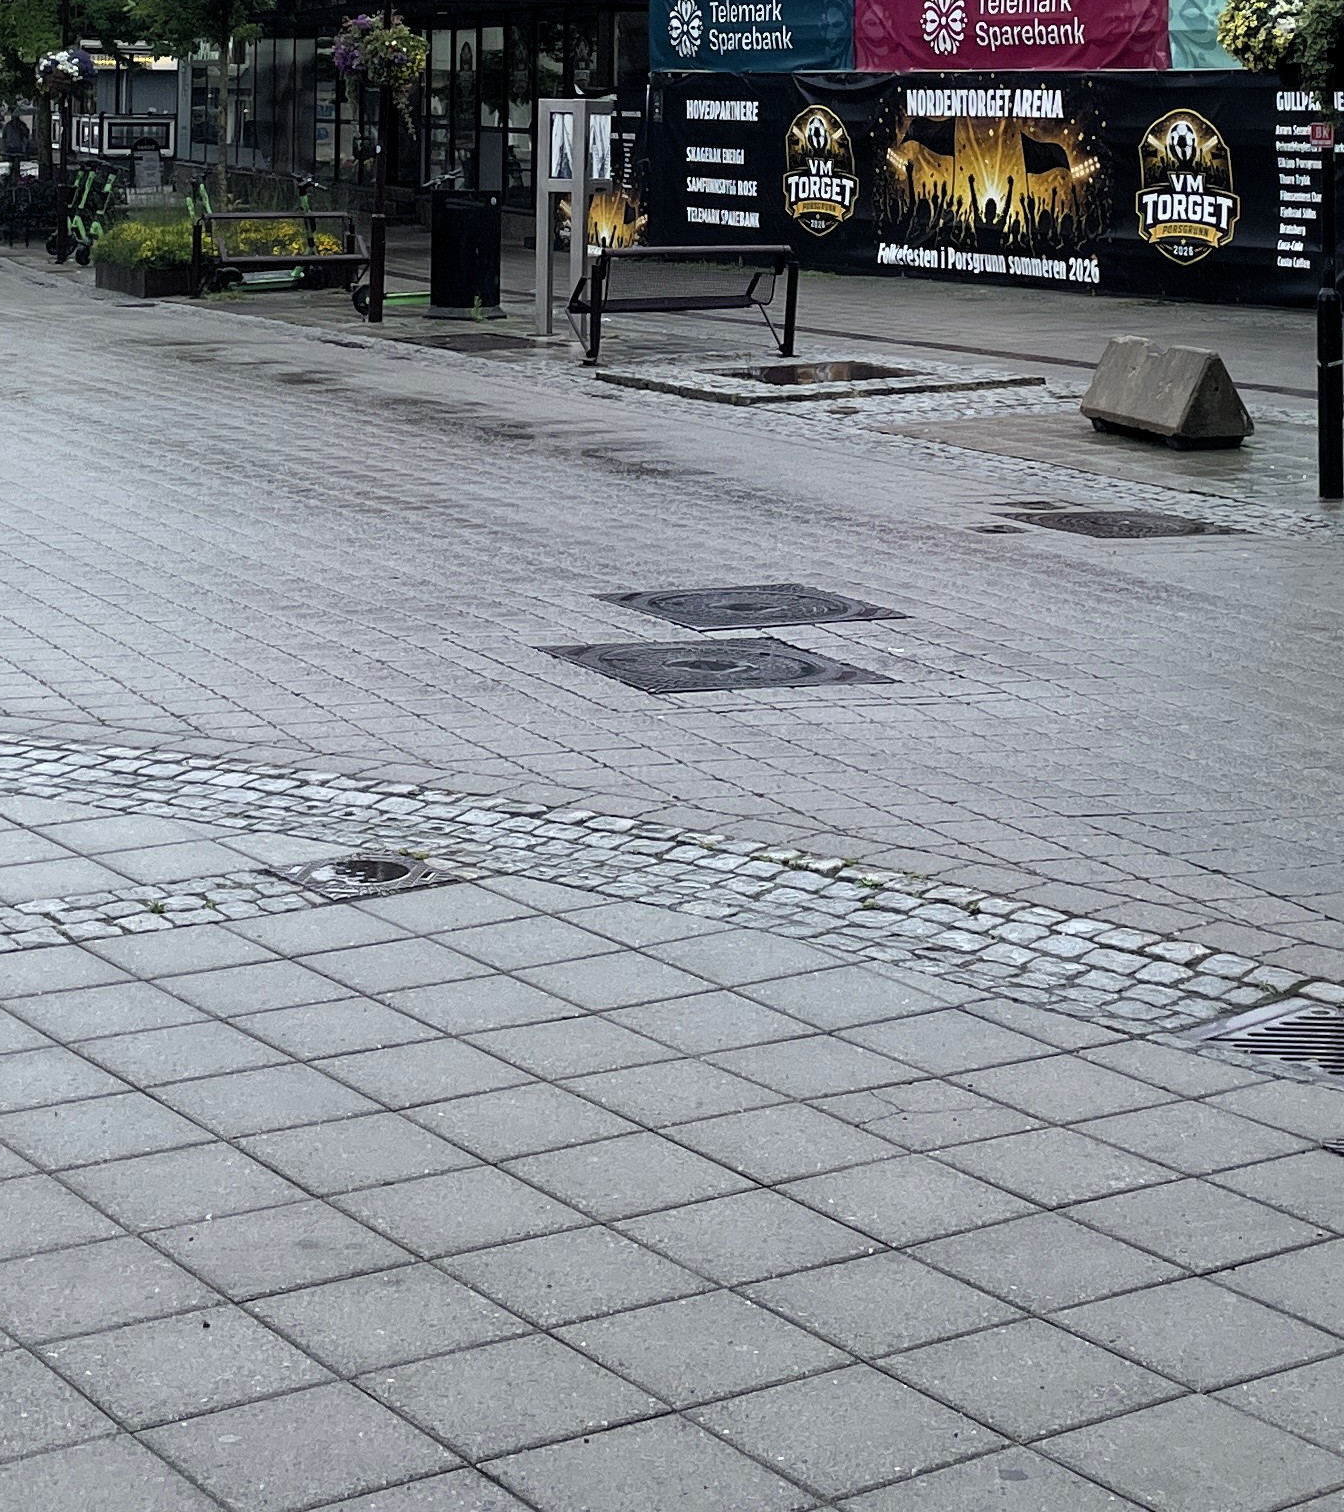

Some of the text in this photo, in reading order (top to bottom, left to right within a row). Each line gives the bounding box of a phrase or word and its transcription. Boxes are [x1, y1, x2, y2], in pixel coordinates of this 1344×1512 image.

[708, 27, 793, 52] Sparebank
[975, 19, 1086, 48] Sparebank
[686, 100, 759, 121] HOVEDPARTNERE
[906, 89, 1064, 119] NORDENTORGET ARENA
[808, 159, 833, 176] VM
[787, 175, 854, 207] TORGET
[1170, 174, 1205, 193] VM
[1141, 192, 1233, 226] TORGET
[877, 242, 1100, 284] Folkefesten i Porsgrunn sommeren 2026
[1172, 244, 1195, 257] 2026
